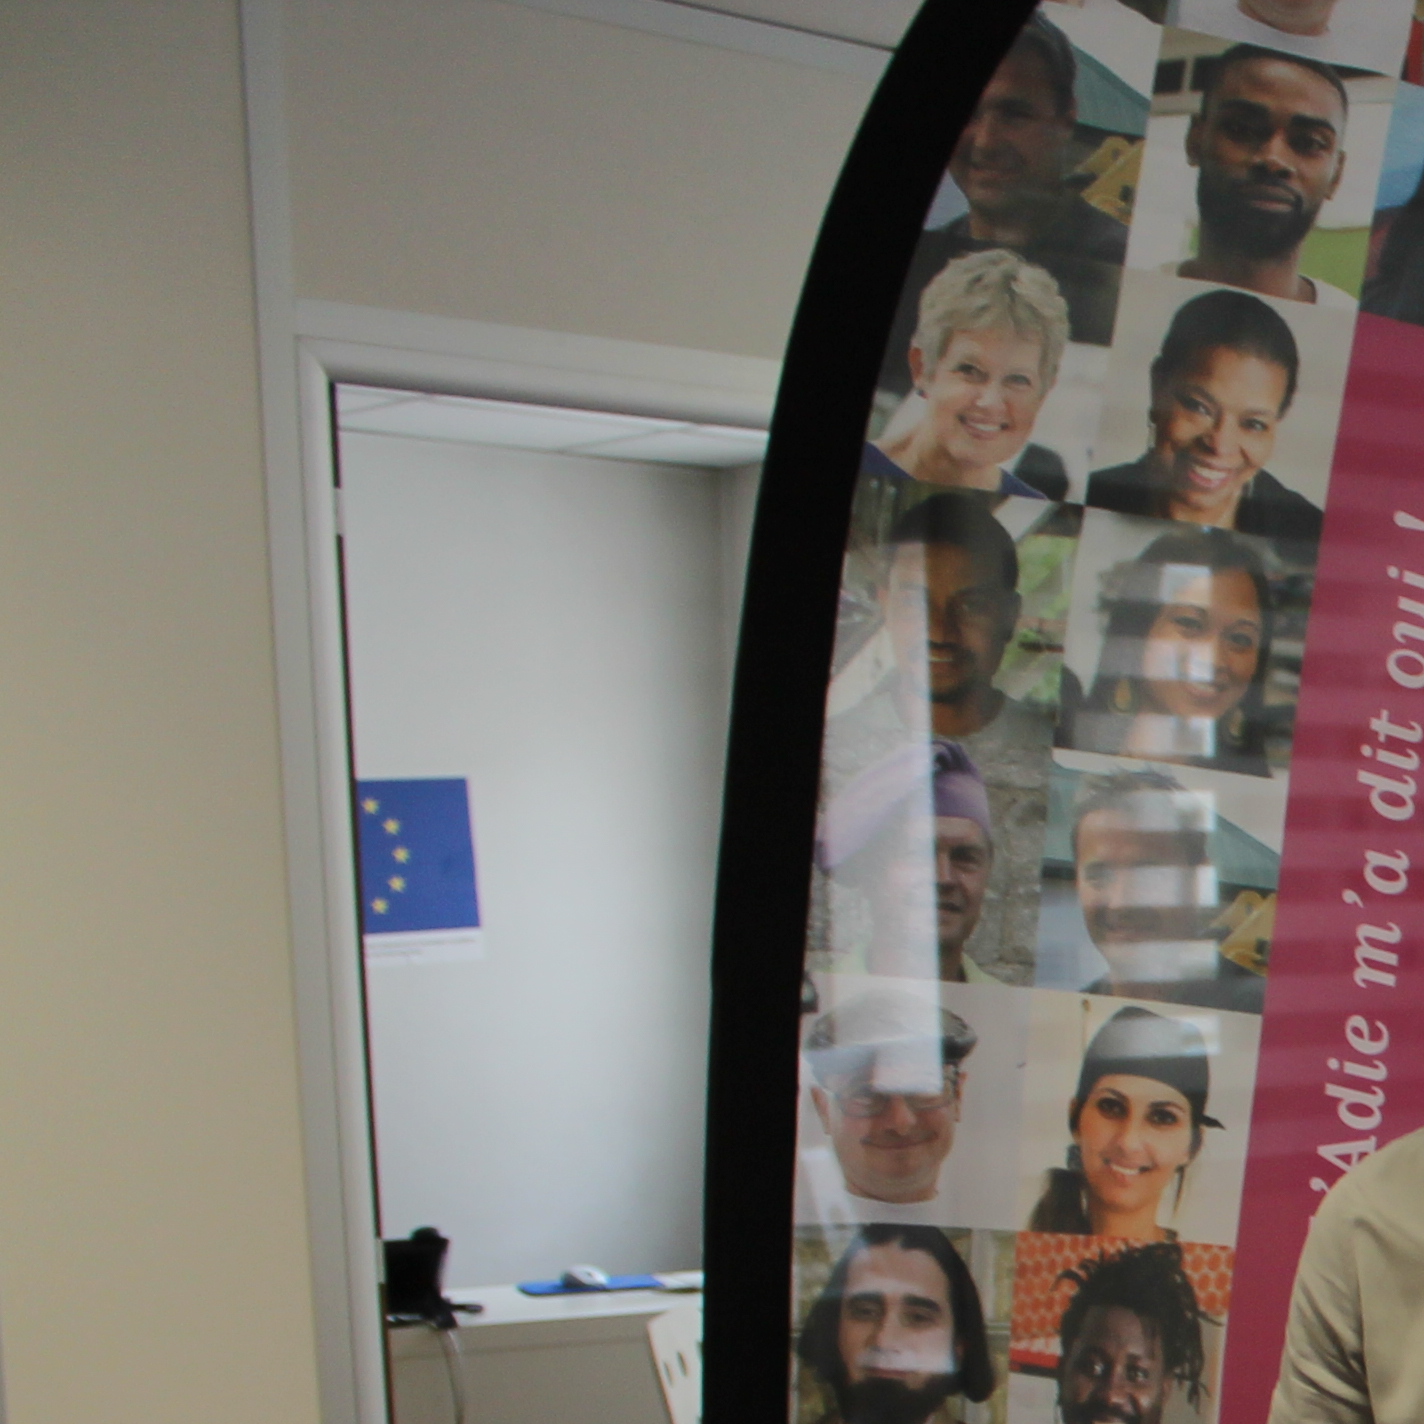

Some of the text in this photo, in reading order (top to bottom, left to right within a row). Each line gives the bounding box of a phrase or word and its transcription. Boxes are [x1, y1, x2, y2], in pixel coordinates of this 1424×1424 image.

[1357, 707, 1424, 822] dit
[1341, 849, 1410, 988] m'a
[1308, 1015, 1390, 1236] 'Adie
